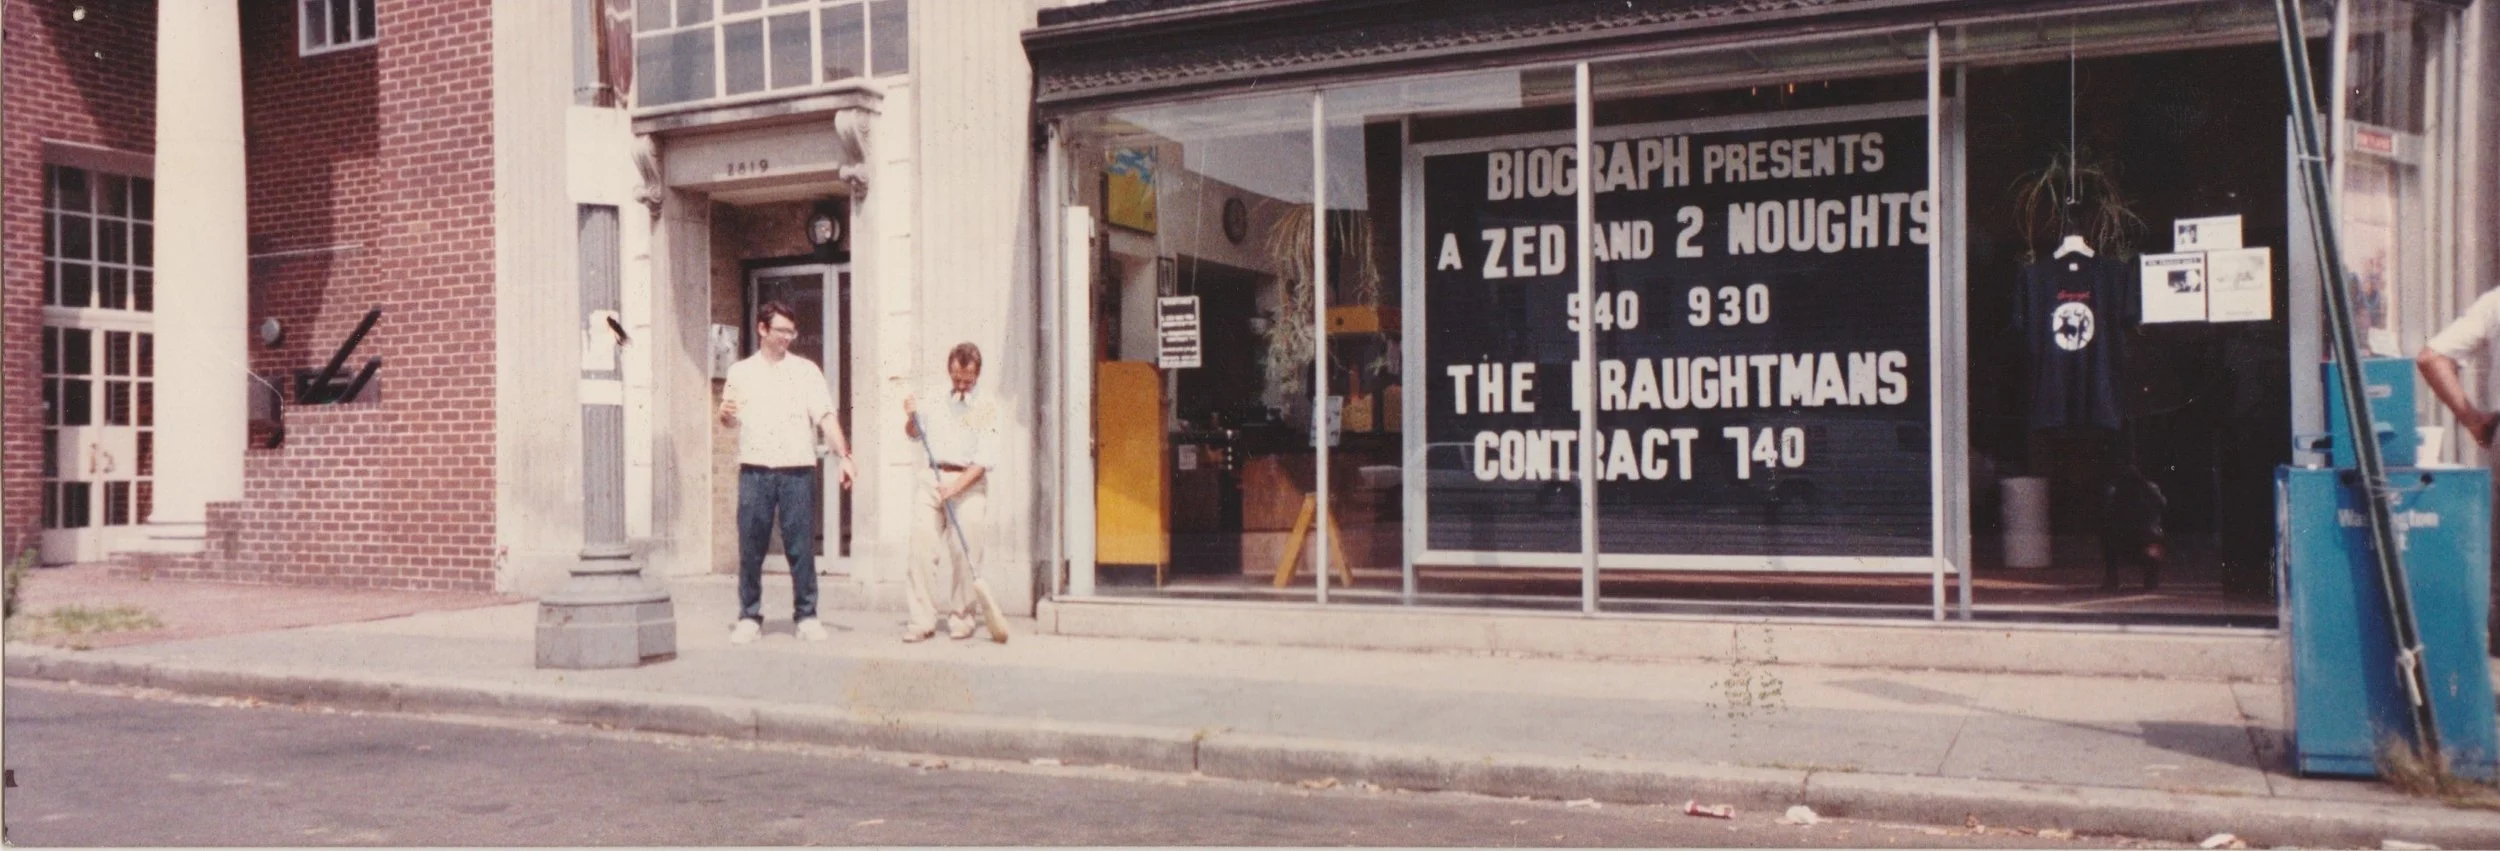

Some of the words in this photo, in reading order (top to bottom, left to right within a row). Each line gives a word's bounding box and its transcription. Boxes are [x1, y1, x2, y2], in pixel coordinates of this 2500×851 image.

[1703, 132, 1885, 185] PRESENTS
[1437, 232, 1464, 271] A
[1481, 224, 1566, 279] ZED
[1592, 220, 1654, 262] AND
[1676, 205, 1704, 258] 2
[1727, 190, 1930, 256] NOUGHTS
[1567, 290, 1639, 332] 540
[1688, 284, 1770, 327] 930
[1447, 362, 1536, 415] THE
[1722, 426, 1805, 480] 740
